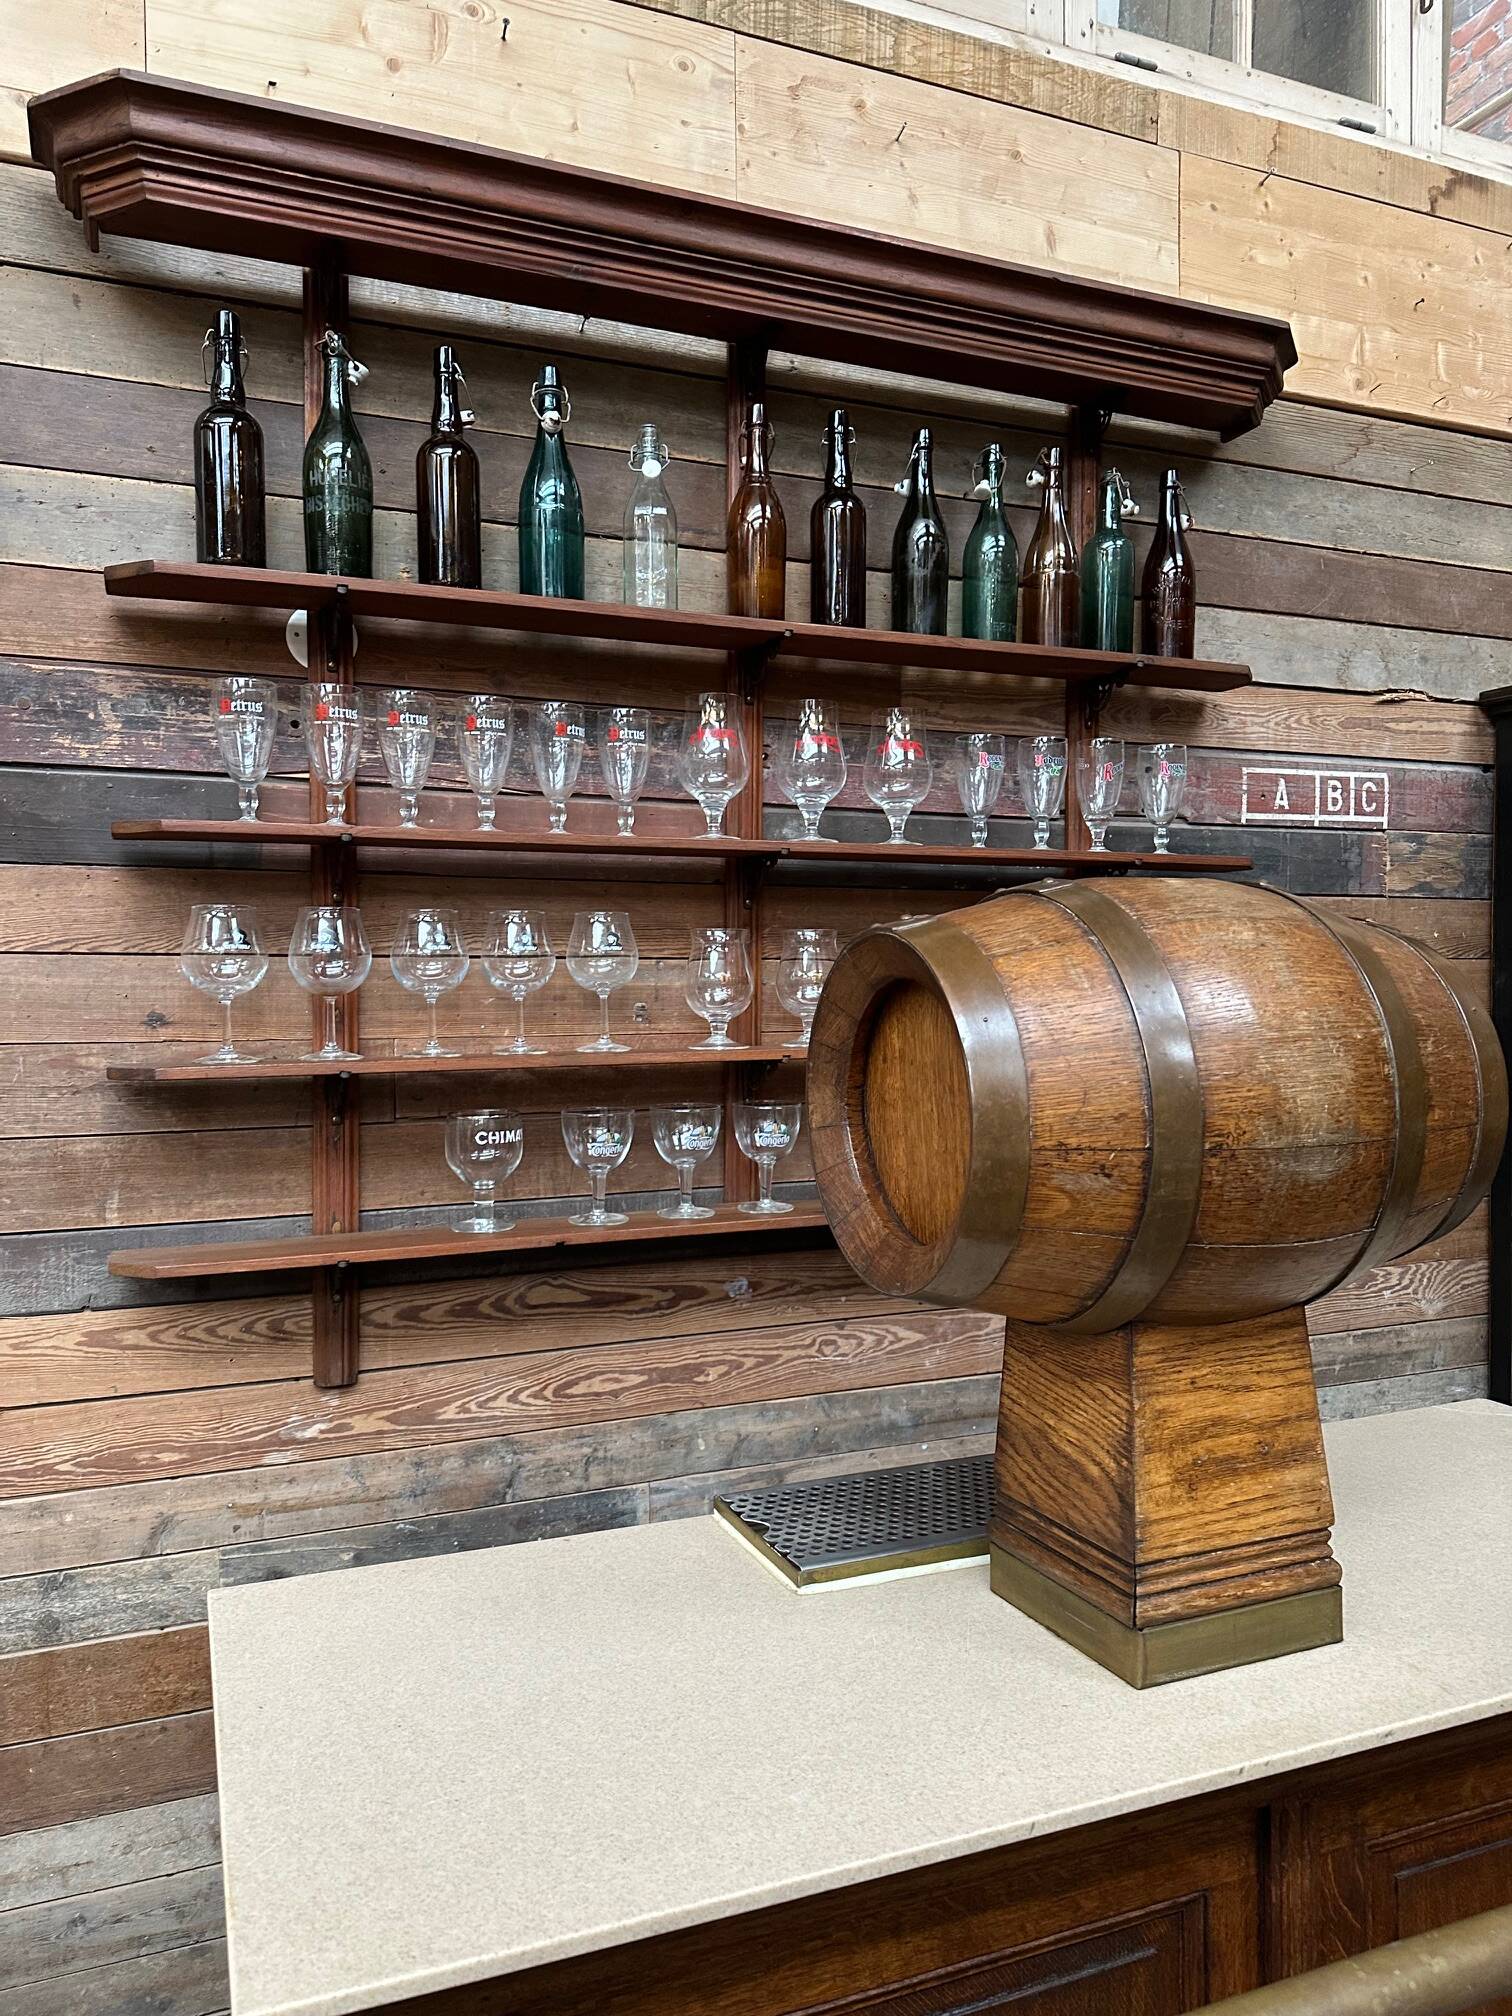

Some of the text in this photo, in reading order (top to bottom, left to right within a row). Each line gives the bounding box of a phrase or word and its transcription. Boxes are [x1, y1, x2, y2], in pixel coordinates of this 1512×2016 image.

[219, 697, 263, 715] Petrus
[315, 703, 358, 721] Petrus
[387, 709, 429, 727] Petrus
[465, 714, 506, 732] Petrus
[607, 726, 646, 742] Petrus
[1273, 777, 1377, 812] A B C
